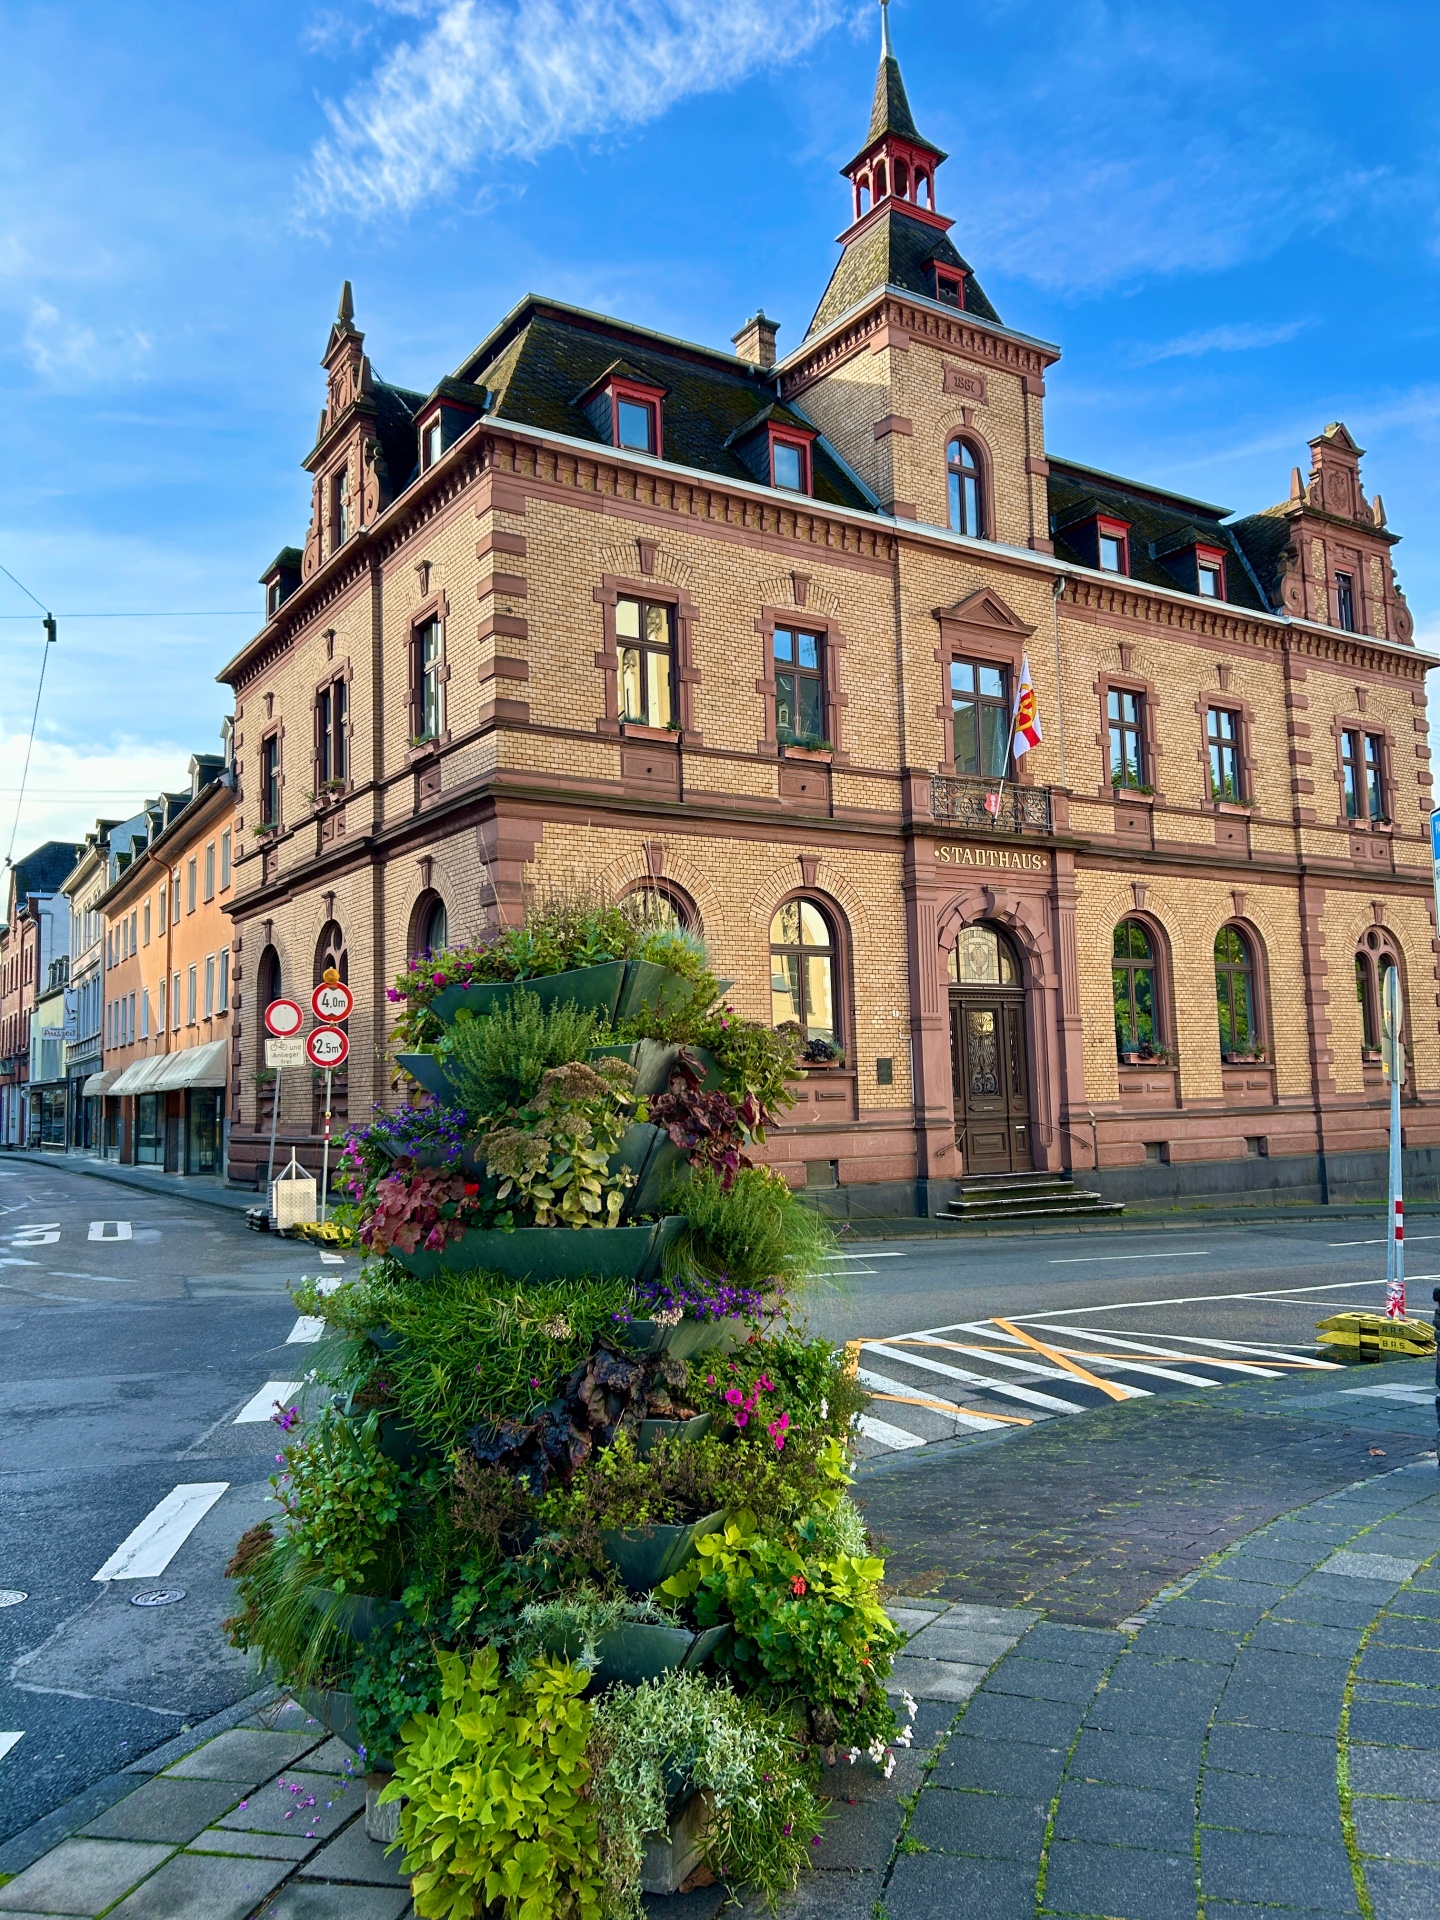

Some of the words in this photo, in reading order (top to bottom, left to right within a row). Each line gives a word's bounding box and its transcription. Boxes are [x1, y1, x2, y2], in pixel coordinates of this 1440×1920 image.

[939, 845, 1042, 871] STADTHAUS
[43, 1029, 76, 1039] Auszeit
[272, 1051, 300, 1059] Anlieger
